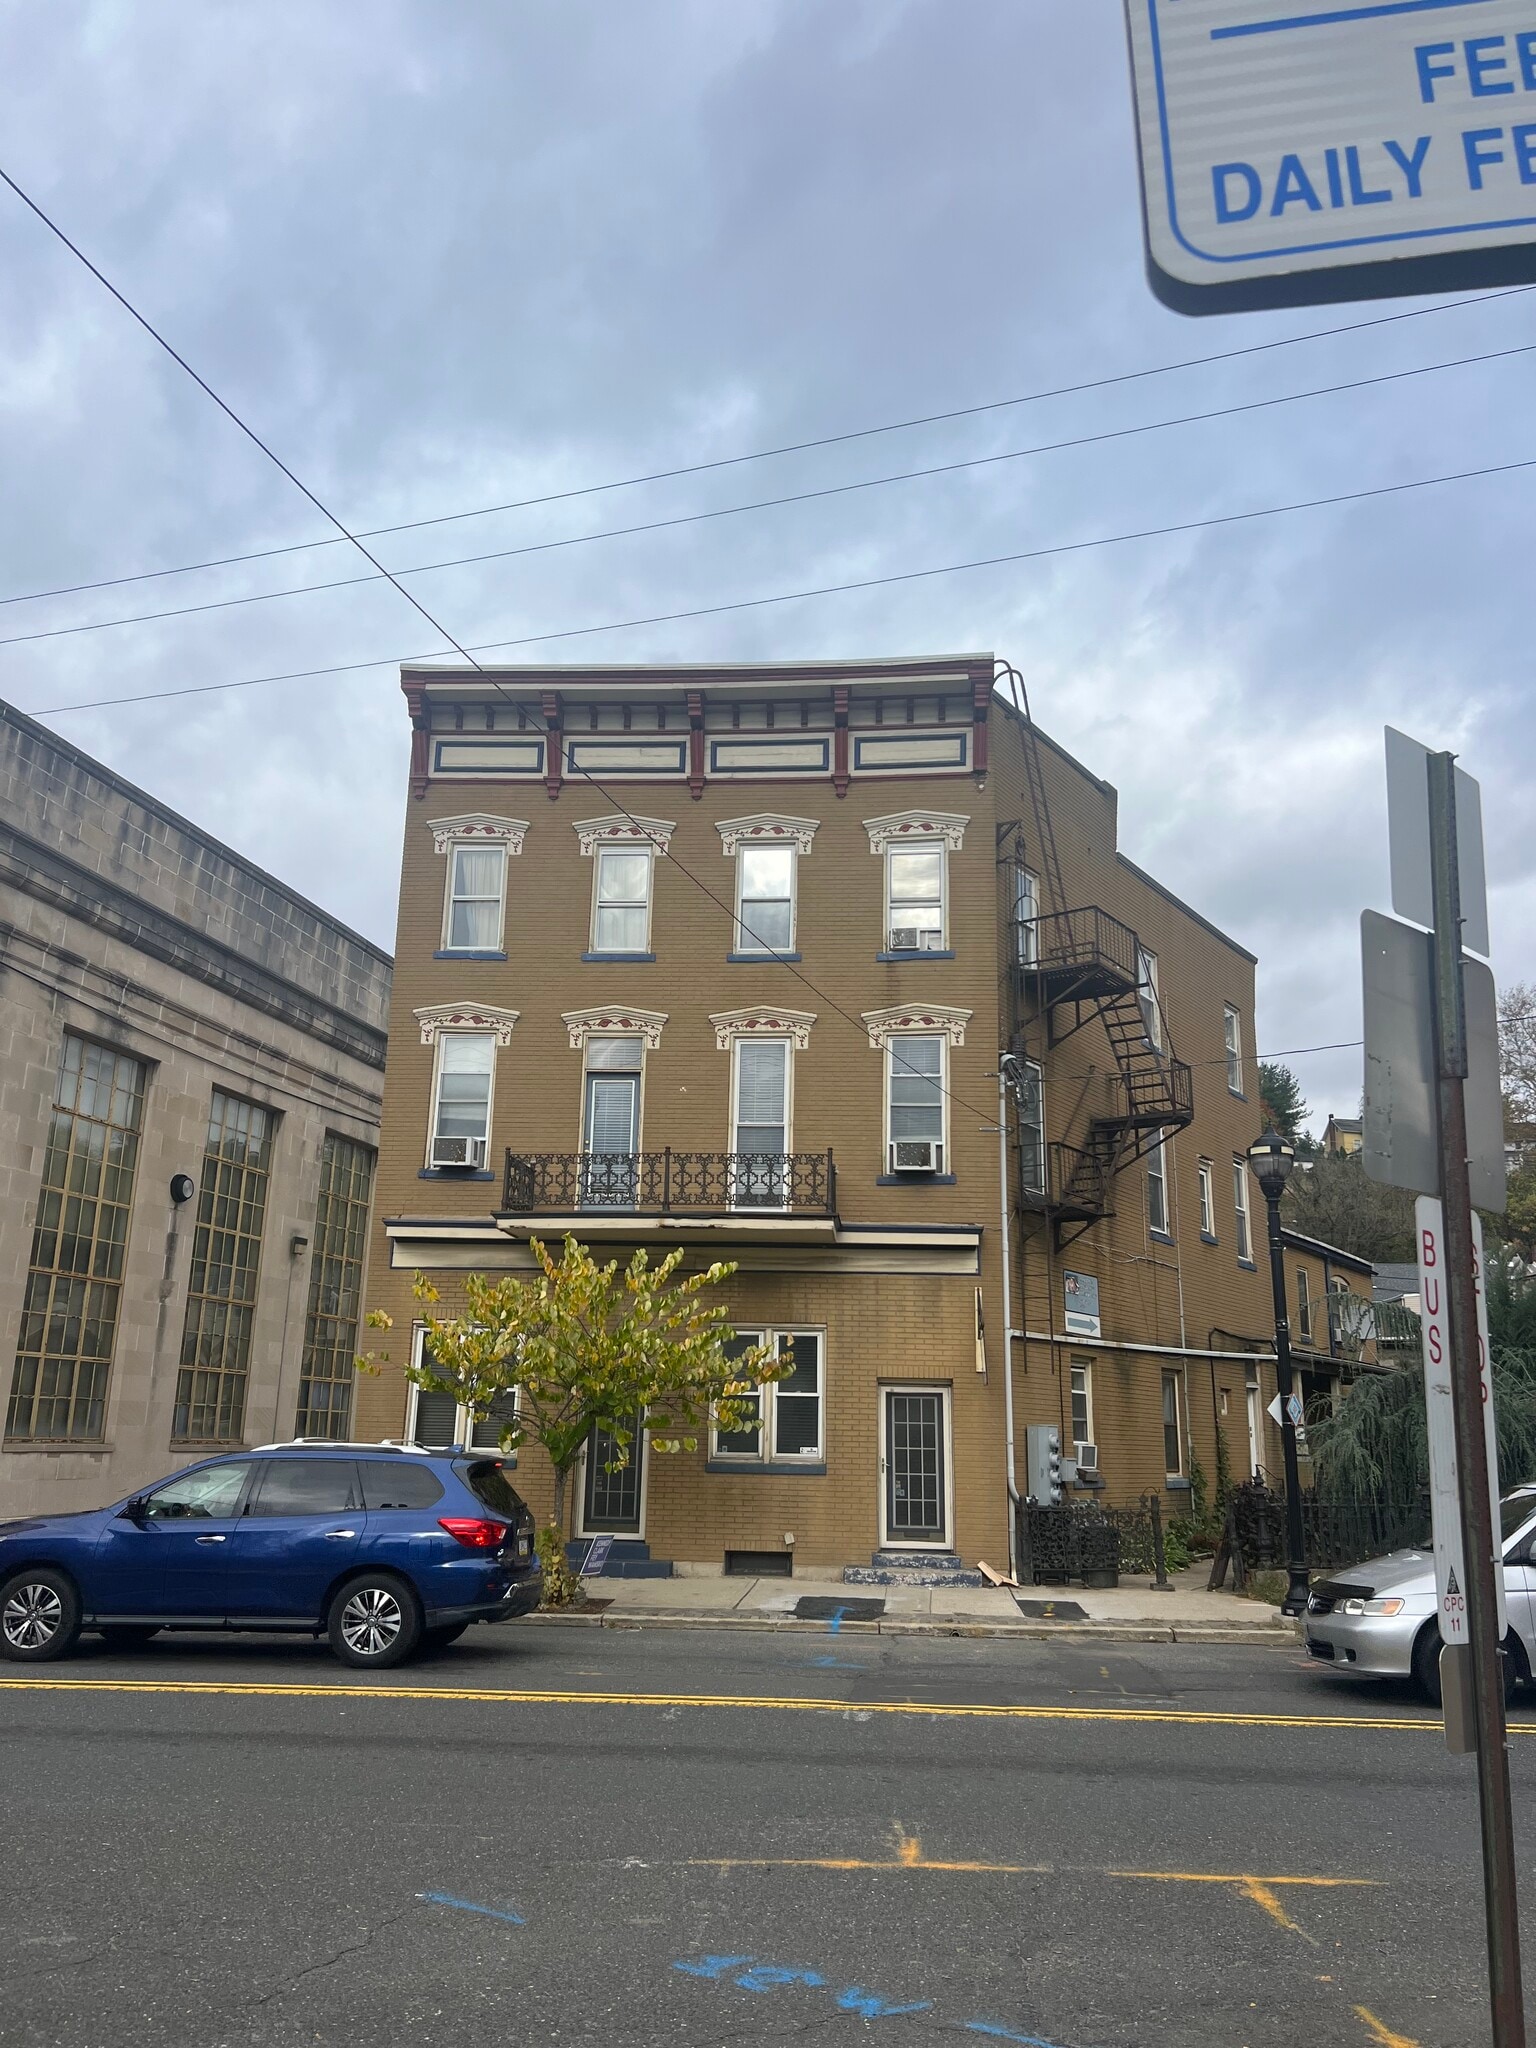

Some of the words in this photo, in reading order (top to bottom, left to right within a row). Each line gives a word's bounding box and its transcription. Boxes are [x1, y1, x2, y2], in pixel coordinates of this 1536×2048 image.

[1211, 136, 1432, 225] DAILY
[1422, 1230, 1442, 1364] BUS
[1444, 1597, 1464, 1612] CPC
[1451, 1618, 1461, 1632] 11
